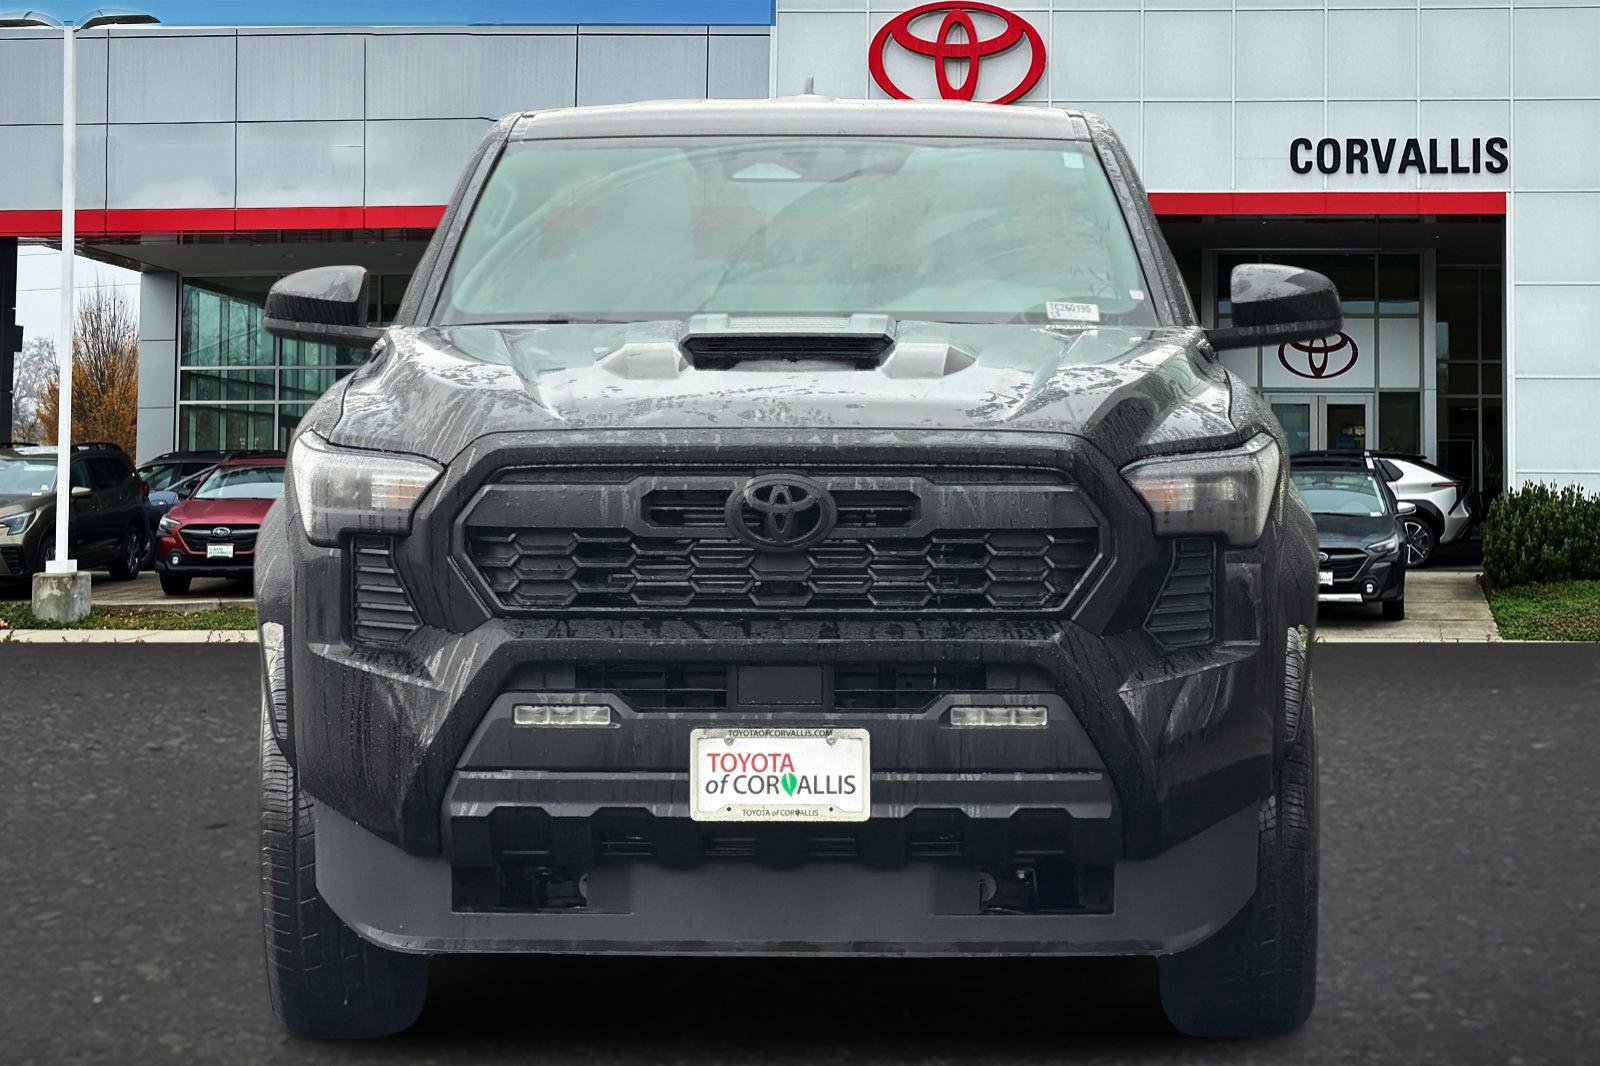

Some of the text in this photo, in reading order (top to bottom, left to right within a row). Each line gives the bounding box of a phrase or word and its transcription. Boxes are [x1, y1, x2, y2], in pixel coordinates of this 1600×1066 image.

[1290, 137, 1509, 174] CORVALLIS
[707, 753, 795, 773] TOYOTA
[705, 774, 730, 795] of
[742, 809, 770, 817] TOYOTA
[771, 808, 779, 816] of
